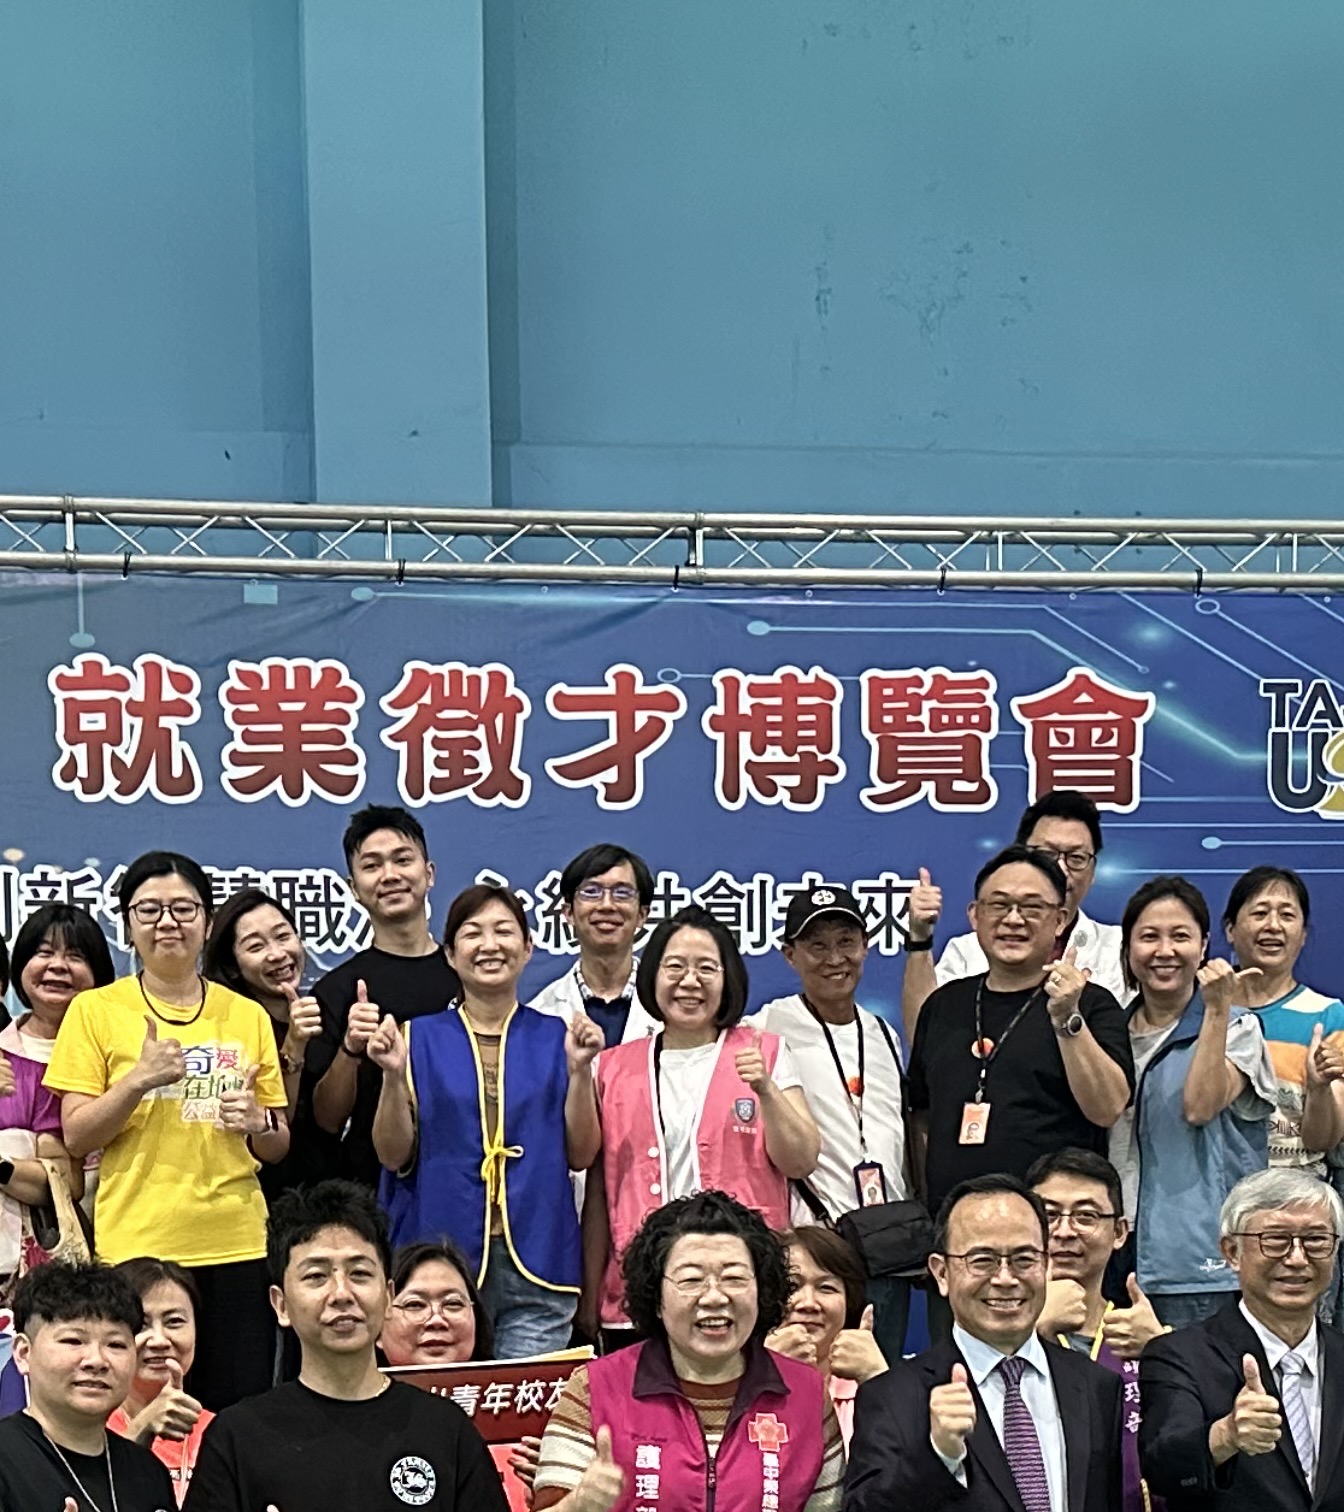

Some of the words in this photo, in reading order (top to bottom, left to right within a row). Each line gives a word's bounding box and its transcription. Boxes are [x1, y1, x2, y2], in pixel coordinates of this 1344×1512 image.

[49, 651, 1155, 813] 就業徵才博覽會
